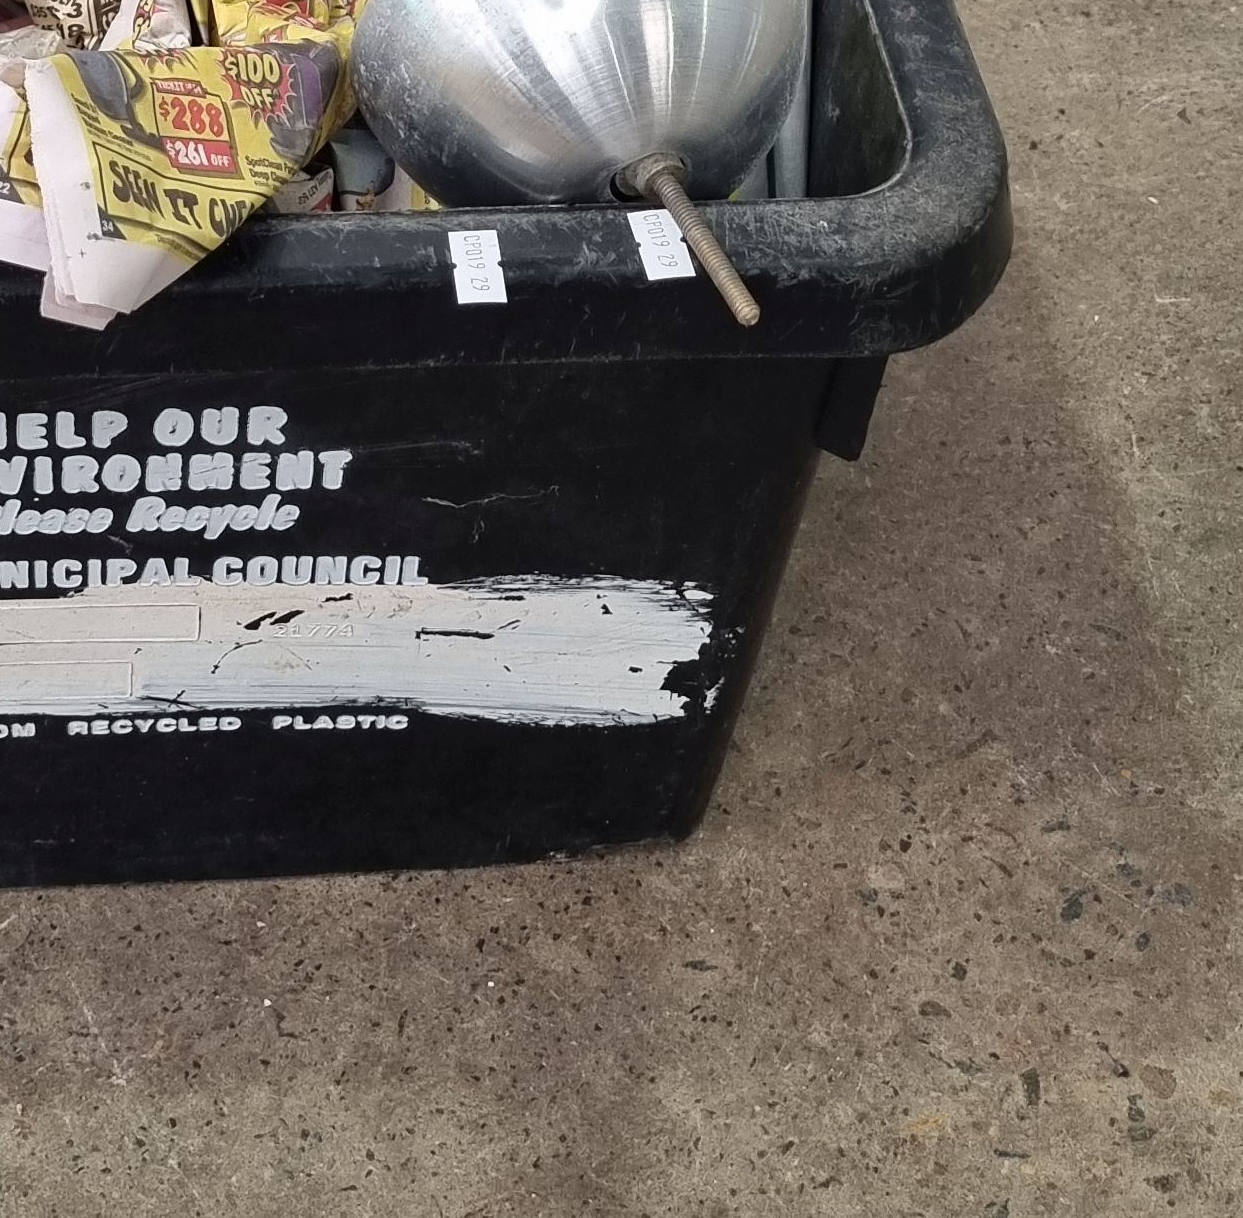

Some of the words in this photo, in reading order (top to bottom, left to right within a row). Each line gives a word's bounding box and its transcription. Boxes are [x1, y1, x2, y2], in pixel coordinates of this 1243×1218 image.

[224, 50, 280, 83] $100
[158, 95, 224, 138] $288
[165, 139, 209, 166] $261
[210, 152, 230, 168] OFF
[108, 159, 167, 220] SEEN
[163, 187, 203, 230] IT
[100, 220, 115, 232] 34
[642, 213, 671, 248] CP019
[659, 253, 679, 269] 29
[463, 234, 486, 270] CP019
[469, 275, 491, 293] 29
[153, 405, 289, 447] OUR
[125, 492, 301, 540] Recycle
[211, 554, 429, 586] COUNCIL
[67, 715, 243, 737] RECYCLED
[271, 713, 410, 732] PLASTIC
